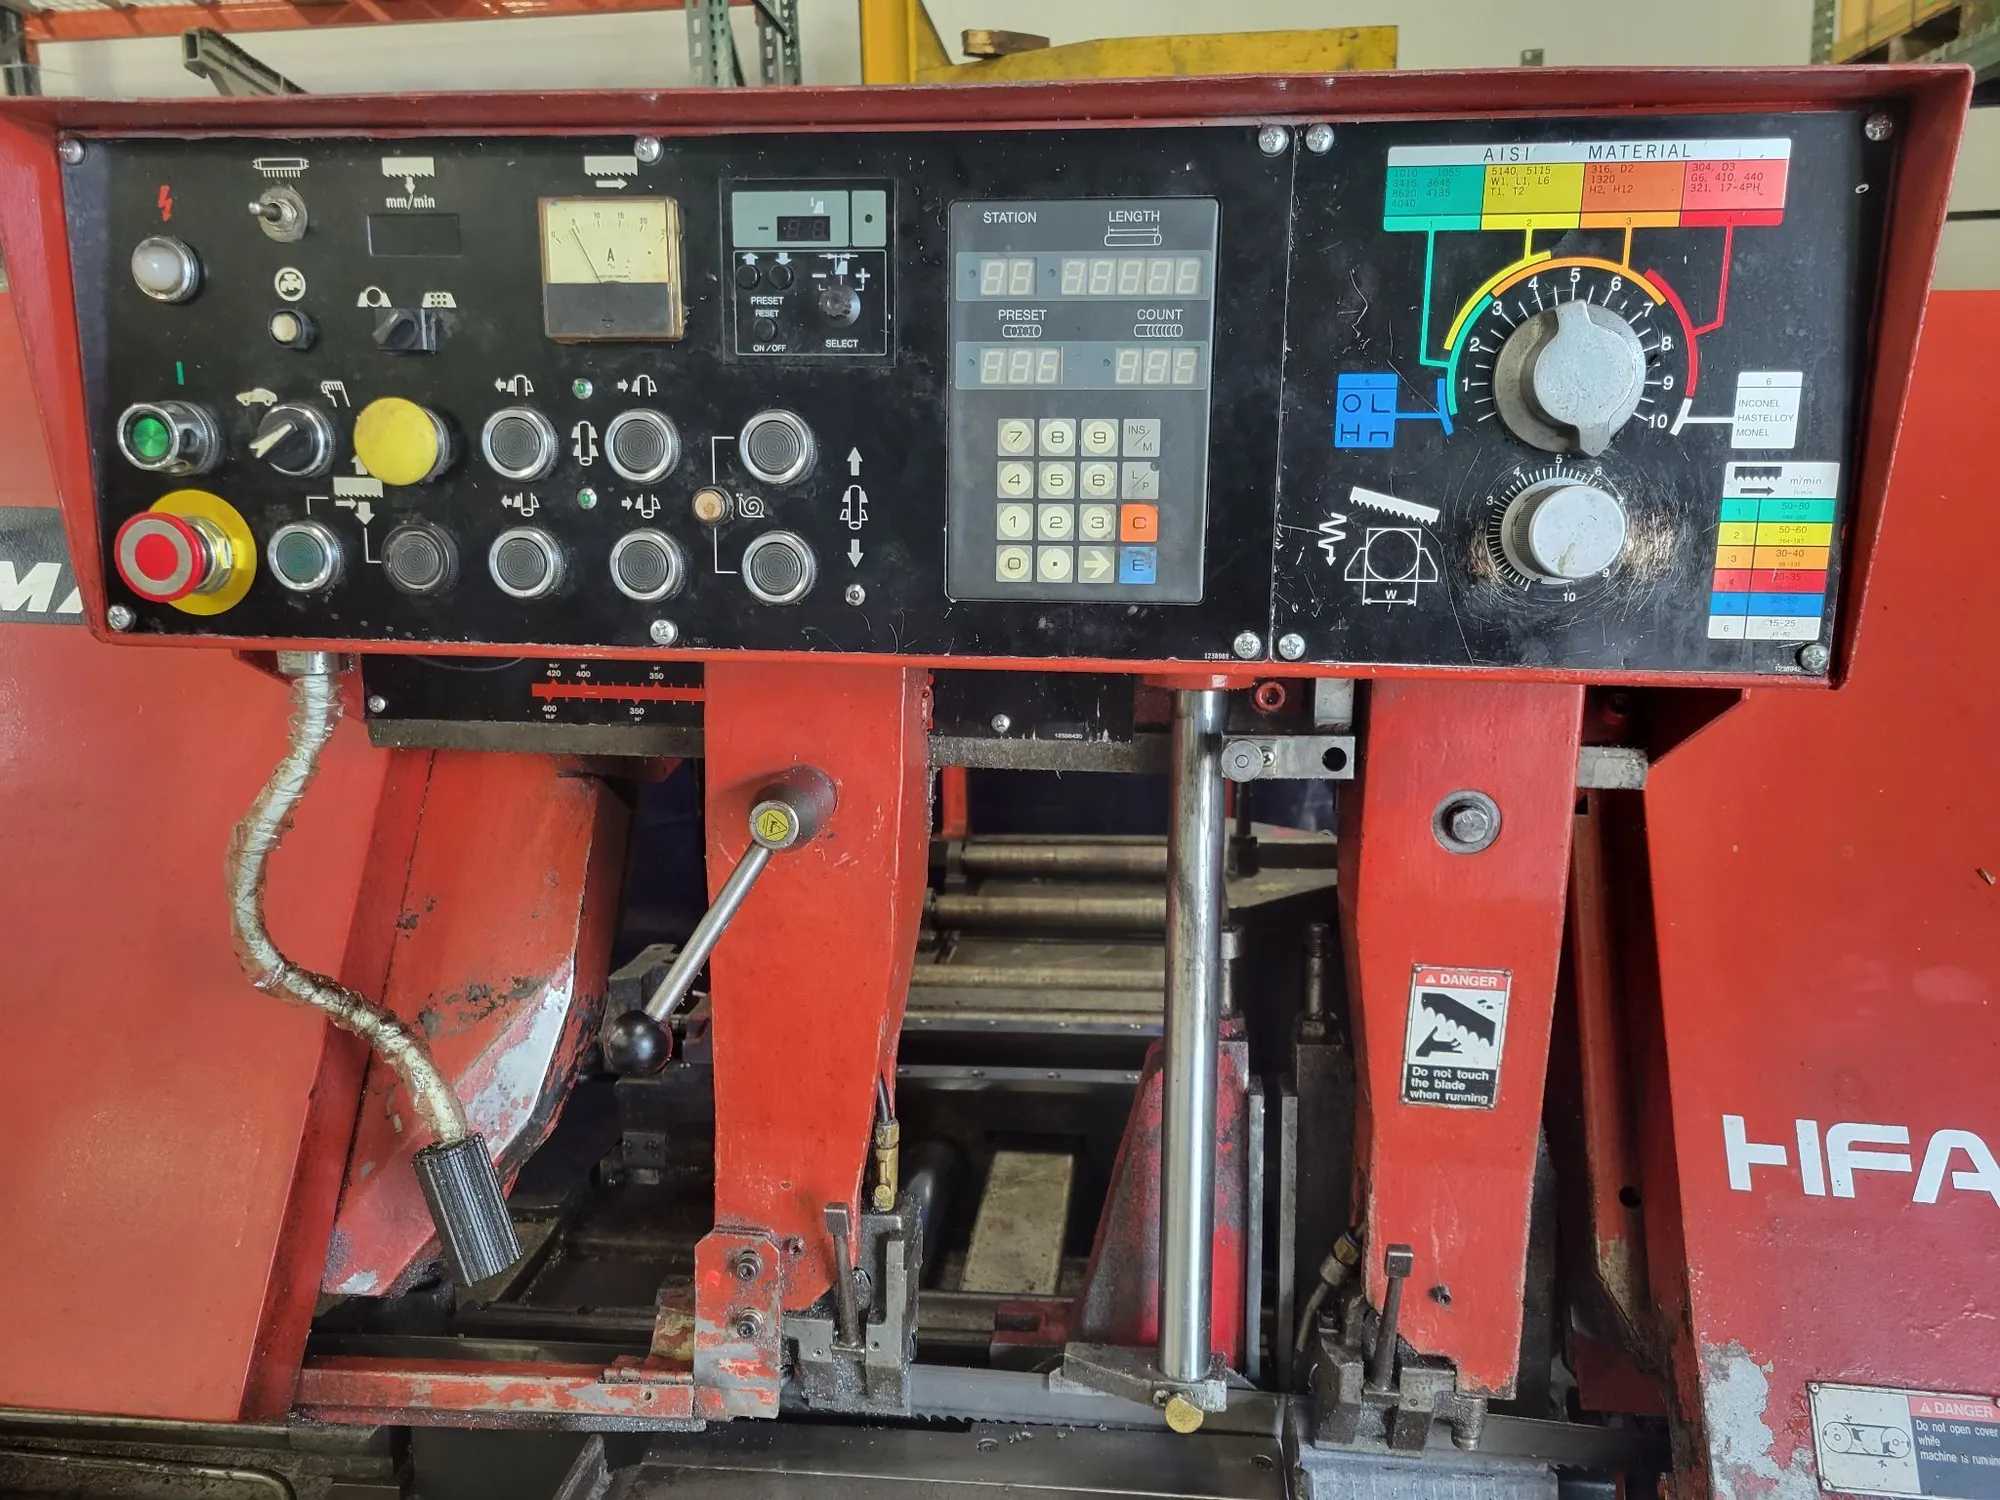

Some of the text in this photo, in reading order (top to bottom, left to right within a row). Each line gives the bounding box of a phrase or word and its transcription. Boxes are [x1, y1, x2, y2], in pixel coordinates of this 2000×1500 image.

[1483, 144, 1691, 161] AISI MATERIAL
[1526, 165, 1551, 174] 5115
[1620, 164, 1634, 173] D2
[1743, 172, 1764, 181] 440
[386, 193, 435, 210] mm/min
[983, 211, 1037, 223] STATION
[1108, 210, 1161, 222] LENGTH
[607, 248, 615, 262] A
[1528, 275, 1539, 289] 4
[1570, 268, 1581, 283] 5
[1610, 276, 1622, 291] 6
[750, 296, 784, 305] PRESET
[755, 309, 780, 318] RESET
[998, 309, 1048, 321] PRESET
[1137, 308, 1184, 321] COUNT
[1492, 301, 1503, 316] 3
[1643, 302, 1654, 317] 7
[825, 339, 859, 348] SELECT
[1469, 337, 1480, 352] 2
[1660, 336, 1672, 352] 8
[1462, 377, 1469, 392] 1
[1662, 375, 1674, 391] 9
[1738, 400, 1778, 408] INCONEL
[1649, 413, 1669, 428] 10
[1737, 414, 1794, 422] HASTELLOY
[1009, 431, 1023, 443] 7
[1051, 431, 1064, 443] 8
[1093, 431, 1106, 444] 9
[1736, 428, 1768, 437] MONEL
[1555, 454, 1563, 464] 5
[1513, 467, 1521, 477] 4
[1595, 466, 1602, 476] 6
[1008, 474, 1021, 485] 4
[1050, 474, 1064, 487] 5
[1092, 474, 1105, 487] 6
[1486, 496, 1494, 505] 3
[1009, 515, 1017, 528] 1
[1049, 516, 1063, 529] 2
[1091, 516, 1104, 529] 3
[1133, 517, 1147, 529] C
[1775, 549, 1805, 557] 30-40
[1007, 557, 1021, 570] 0
[1132, 559, 1145, 572] E
[1602, 568, 1610, 577] 9
[1385, 590, 1397, 599] W
[1563, 592, 1576, 602] 10
[576, 670, 591, 678] 400
[649, 672, 664, 680] 350
[630, 707, 645, 715] 350
[1440, 974, 1498, 987] DANGER
[1412, 1066, 1489, 1081] Do not touch
[1411, 1078, 1466, 1091] the blade
[1410, 1088, 1488, 1106] when running
[1934, 1401, 1993, 1418] DANGER
[1916, 1419, 1998, 1438] Do not open cover
[1917, 1433, 1941, 1447] while
[1920, 1450, 1957, 1463] machine
